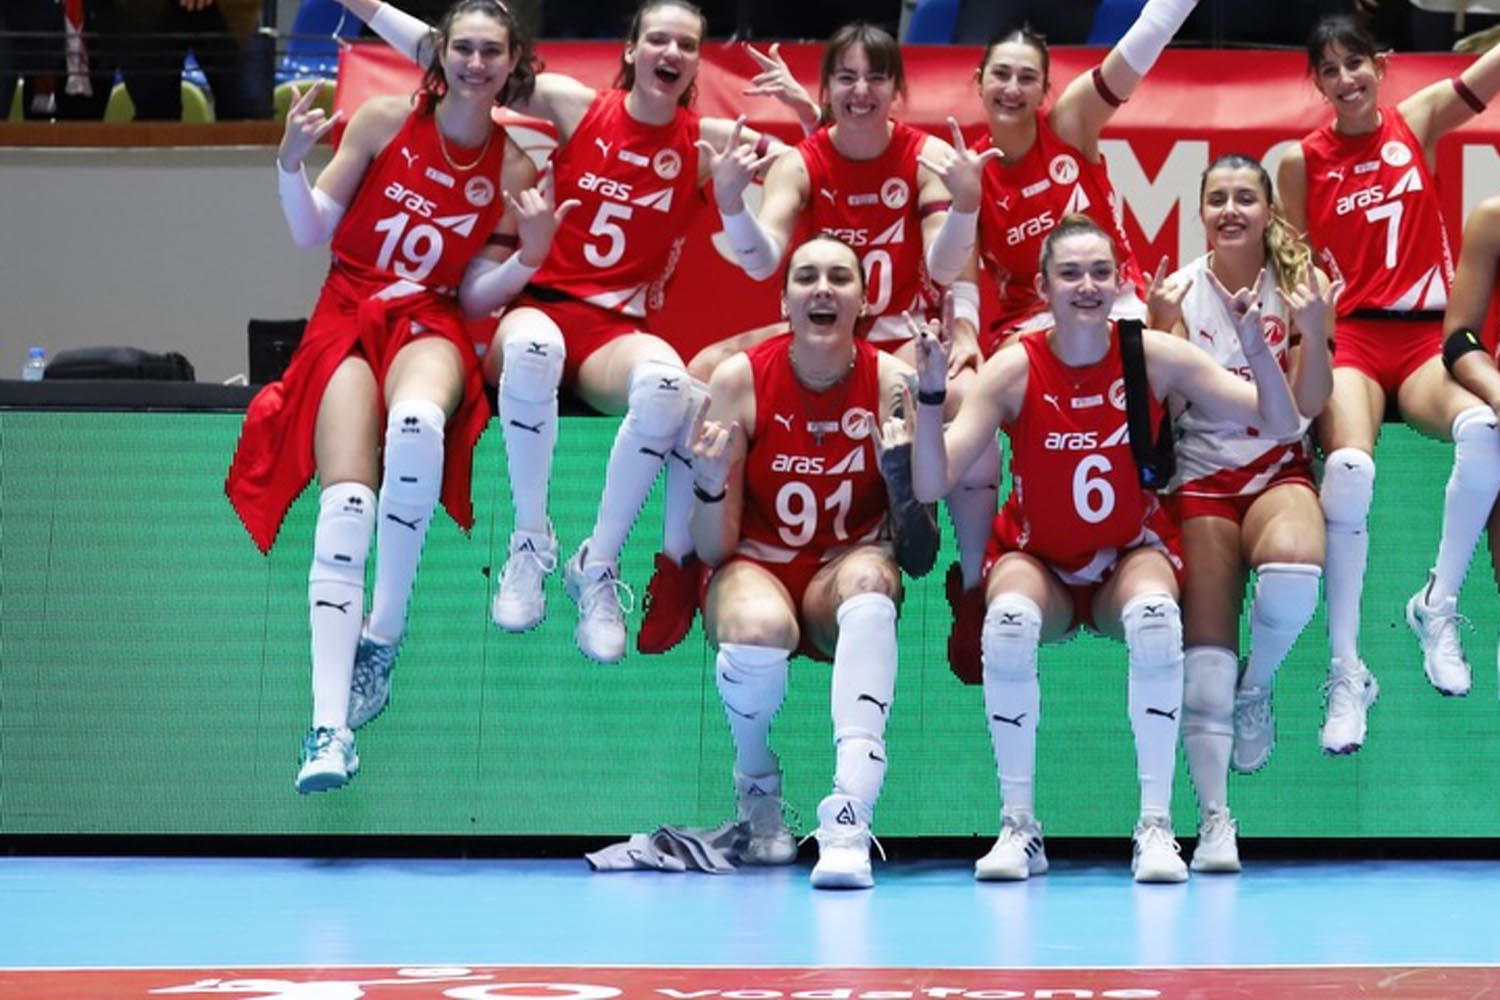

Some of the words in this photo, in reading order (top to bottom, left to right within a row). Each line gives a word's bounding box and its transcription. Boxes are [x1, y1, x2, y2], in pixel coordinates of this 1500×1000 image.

[384, 182, 438, 218] aras
[577, 172, 633, 201] aras
[1336, 184, 1385, 215] aras
[583, 202, 634, 268] 5
[1006, 211, 1055, 246] aras
[1366, 201, 1404, 269] 7
[375, 212, 444, 281] 19
[1045, 431, 1098, 450] aras
[771, 454, 825, 474] aras
[1072, 453, 1115, 523] 6
[775, 480, 853, 547] 91
[655, 988, 1161, 1000] vodafone
